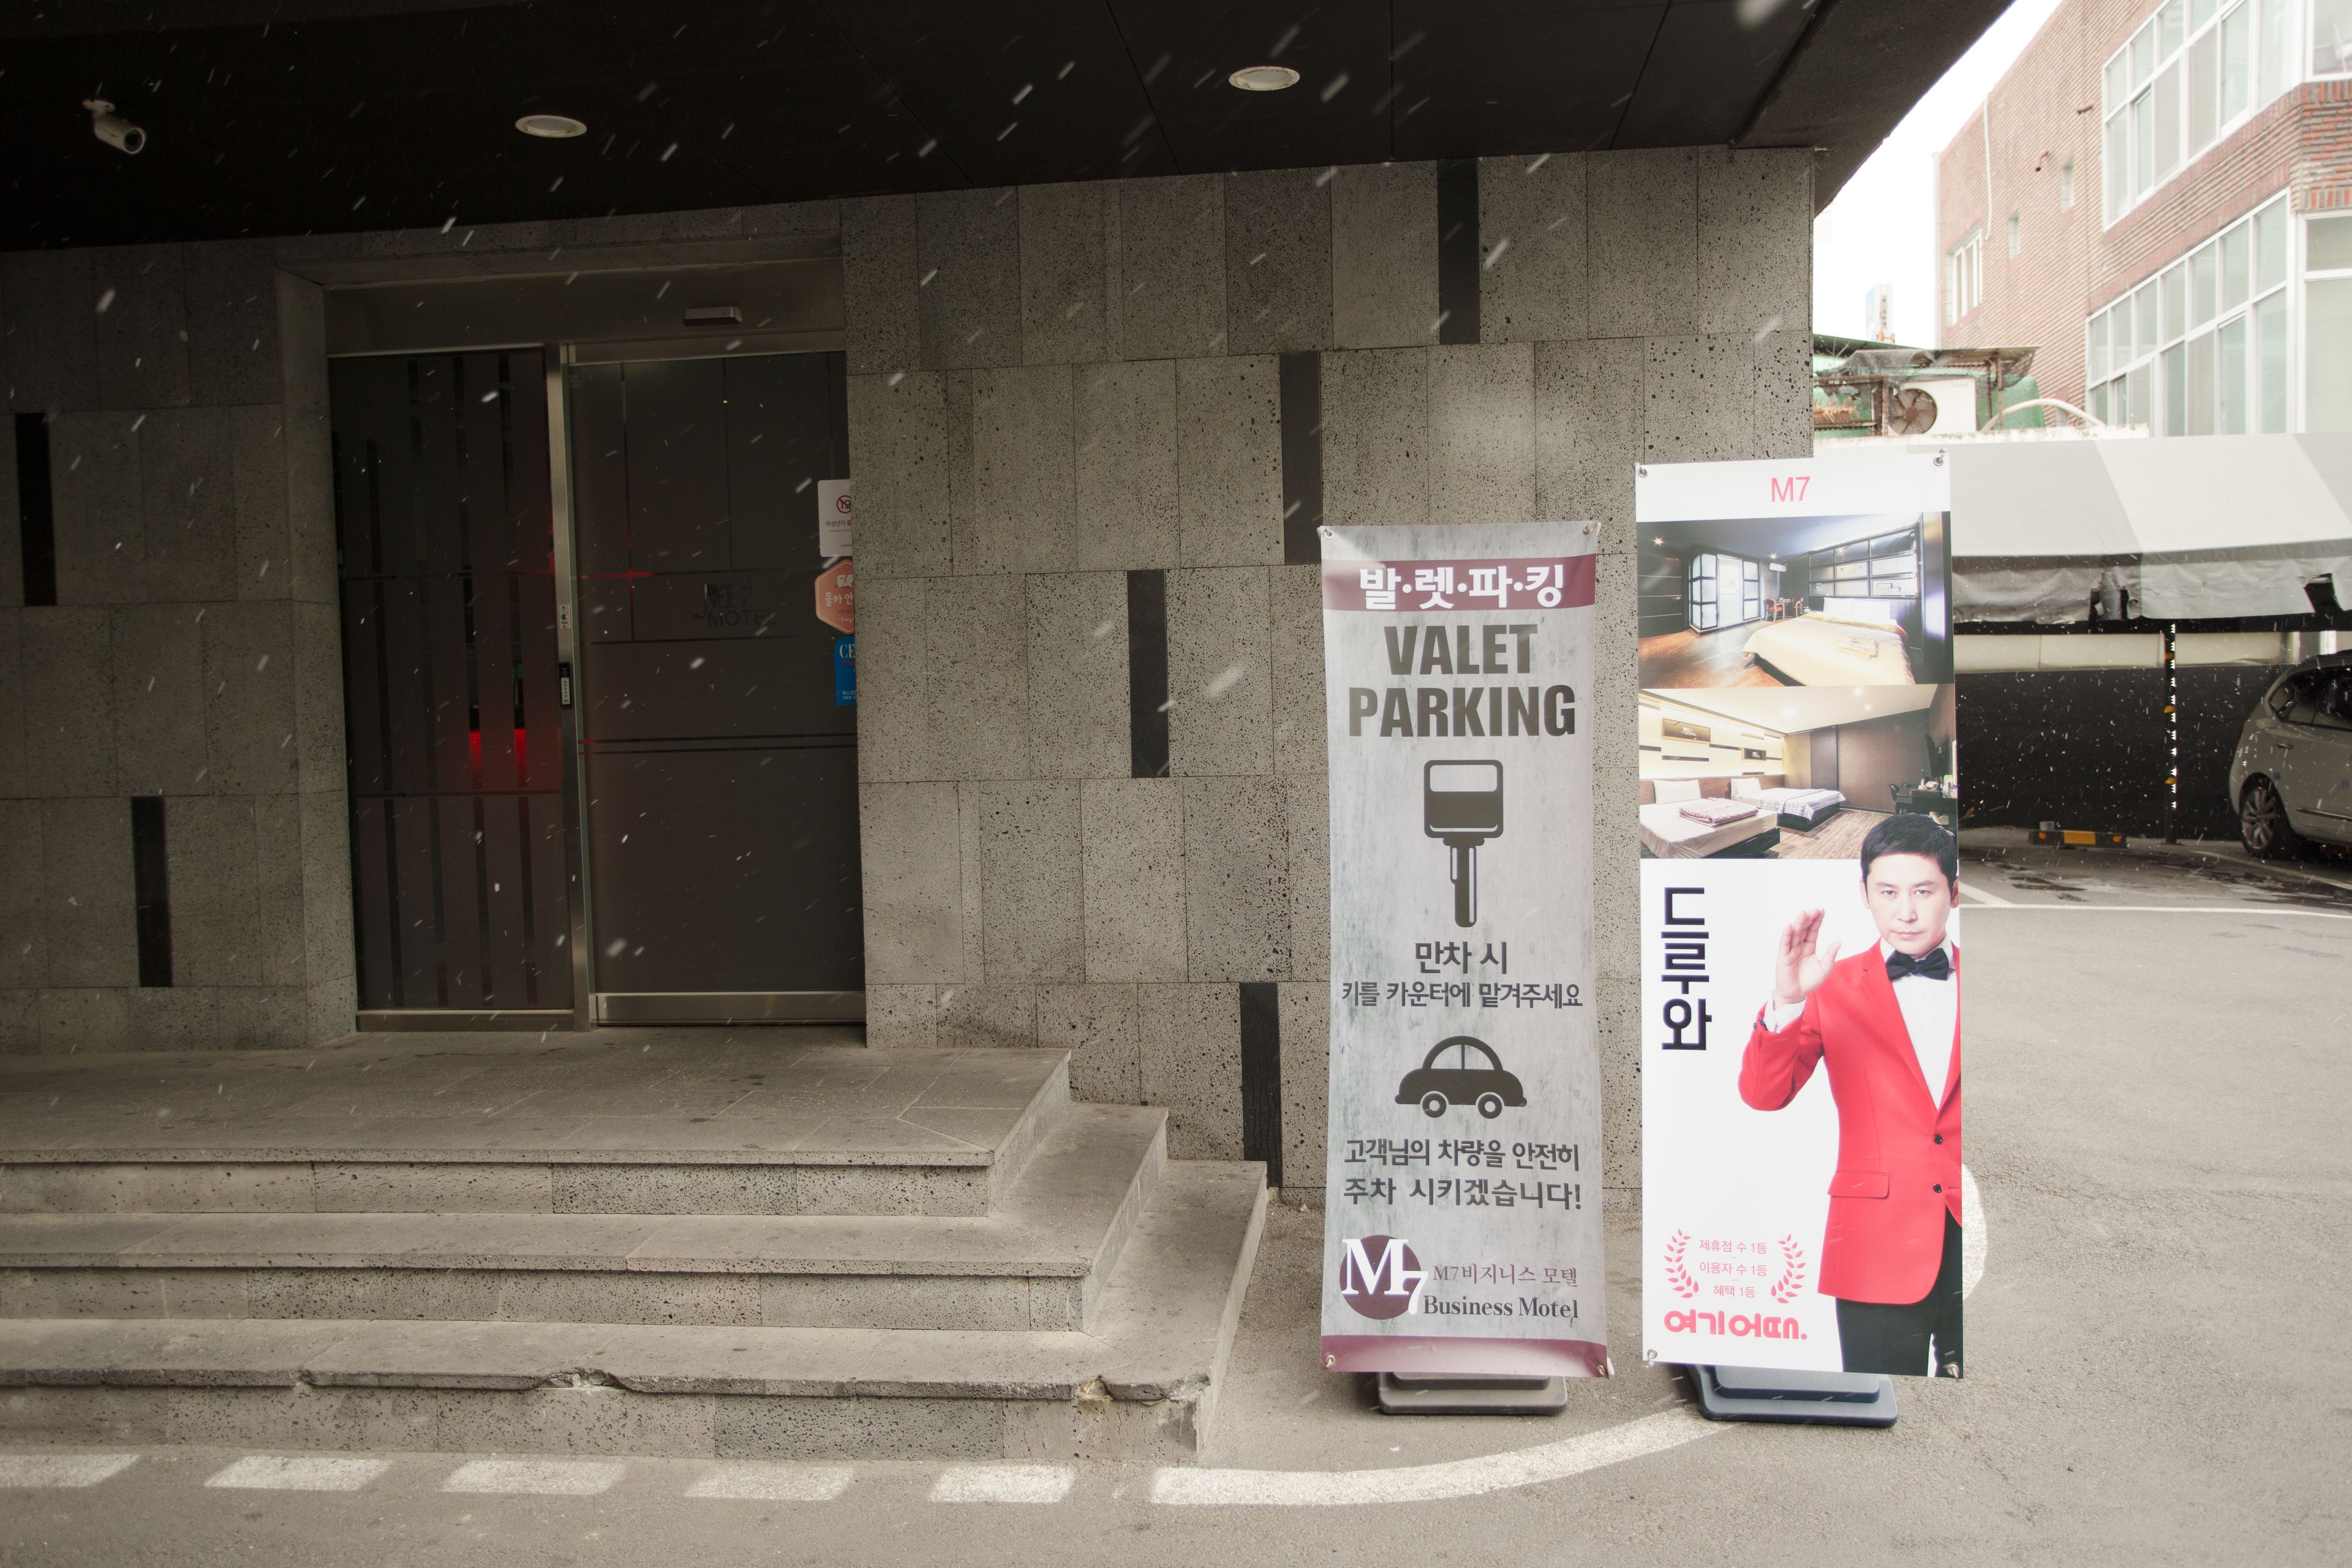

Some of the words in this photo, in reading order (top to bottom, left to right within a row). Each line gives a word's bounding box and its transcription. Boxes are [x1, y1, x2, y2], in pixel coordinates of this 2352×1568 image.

[1770, 477, 1811, 502] M7
[824, 592, 843, 607] 몰카
[845, 592, 854, 605] 안
[707, 609, 777, 627] MOTEL
[1384, 624, 1538, 675] VALET
[1348, 684, 1576, 737] PARKING
[1415, 940, 1472, 974] 만차
[1480, 941, 1507, 974] 시
[1660, 887, 1713, 1051] 드루와
[1341, 981, 1380, 1007] 키를
[1385, 981, 1471, 1008] 카운터에
[1478, 982, 1583, 1009] 맡겨주세요
[1343, 1138, 1430, 1166] 고객님의
[1438, 1139, 1506, 1168] 차량을
[1512, 1141, 1580, 1171] 안전히
[1343, 1177, 1396, 1205] 주차
[1409, 1178, 1582, 1210] 시키겠습니다!
[1698, 1239, 1733, 1253] 제휴점
[1735, 1242, 1747, 1253] 수
[1751, 1242, 1768, 1254] 1등
[1341, 1237, 1428, 1315] M7
[1432, 1263, 1536, 1285] M7비지니스
[1542, 1267, 1578, 1287] 모텔
[1699, 1262, 1733, 1275] 이용자
[1735, 1264, 1747, 1275] 수
[1751, 1264, 1768, 1276] 1등
[1713, 1284, 1735, 1297] 혜택
[1739, 1286, 1756, 1298] 1등
[1423, 1295, 1513, 1316] Business
[1518, 1297, 1580, 1319] Motel
